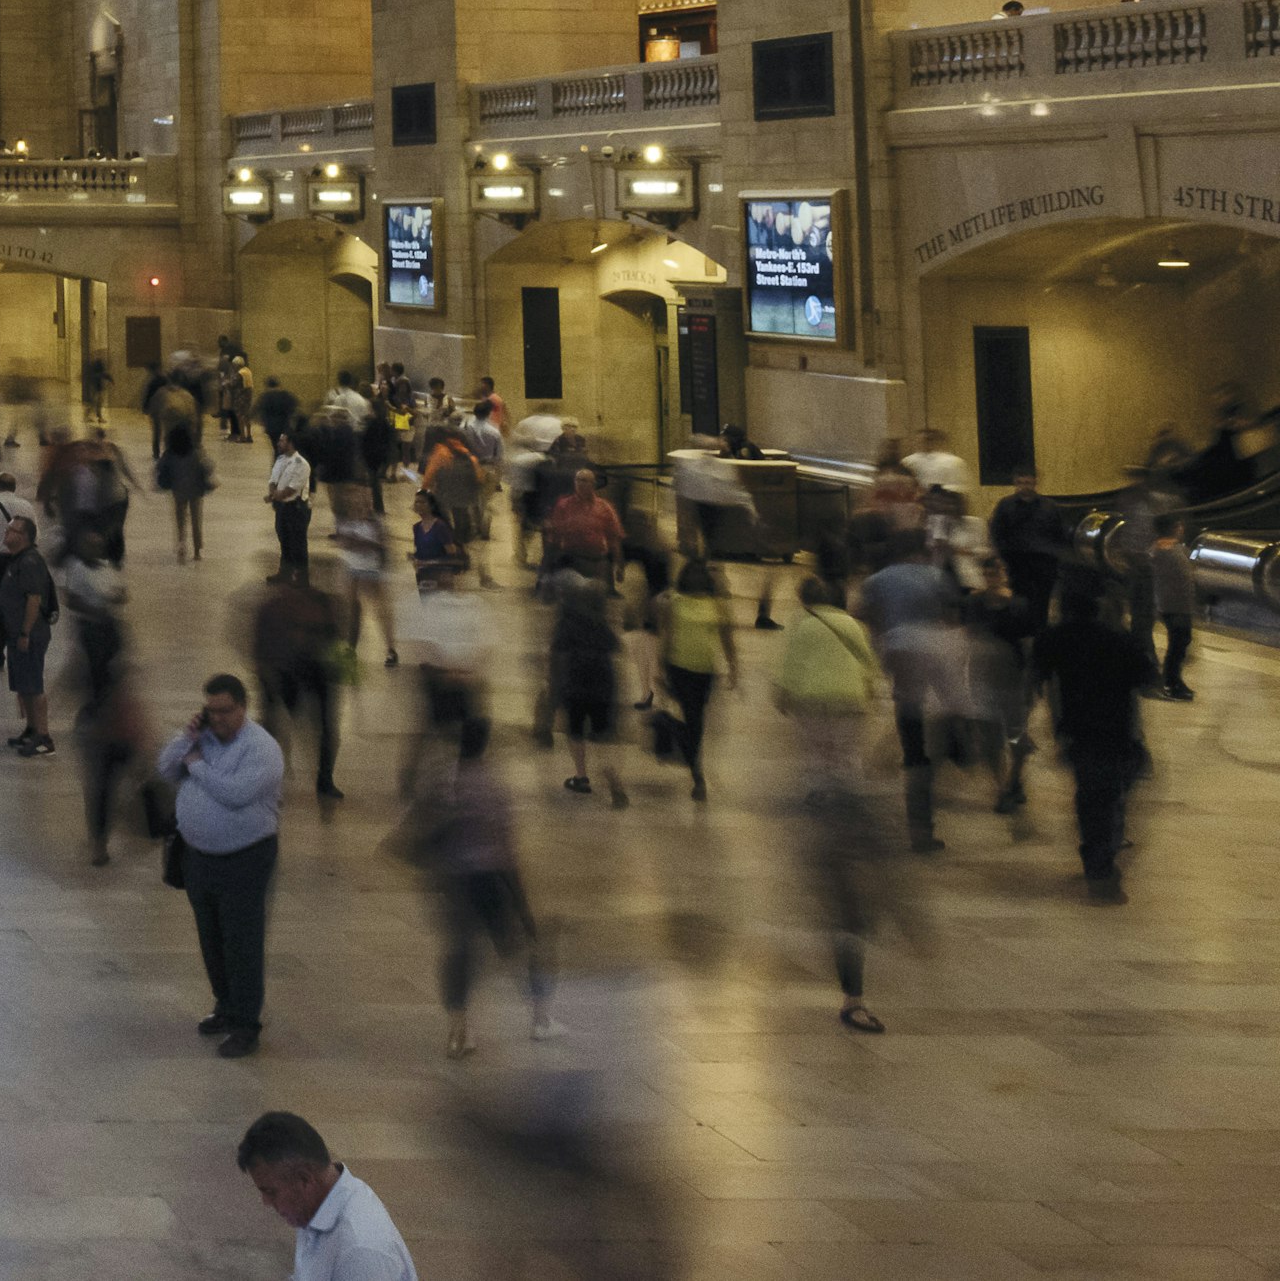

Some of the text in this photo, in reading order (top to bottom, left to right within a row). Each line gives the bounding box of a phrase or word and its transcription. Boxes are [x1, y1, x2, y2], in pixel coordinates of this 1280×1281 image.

[1174, 186, 1280, 224] 45TH STR
[914, 185, 1104, 264] THE METLIFE BUILDING
[17, 246, 36, 260] TO
[40, 252, 54, 264] 42
[754, 248, 807, 260] Metro-North's
[755, 261, 820, 275] Yankees-E. 153rd
[756, 273, 808, 287] Street Station
